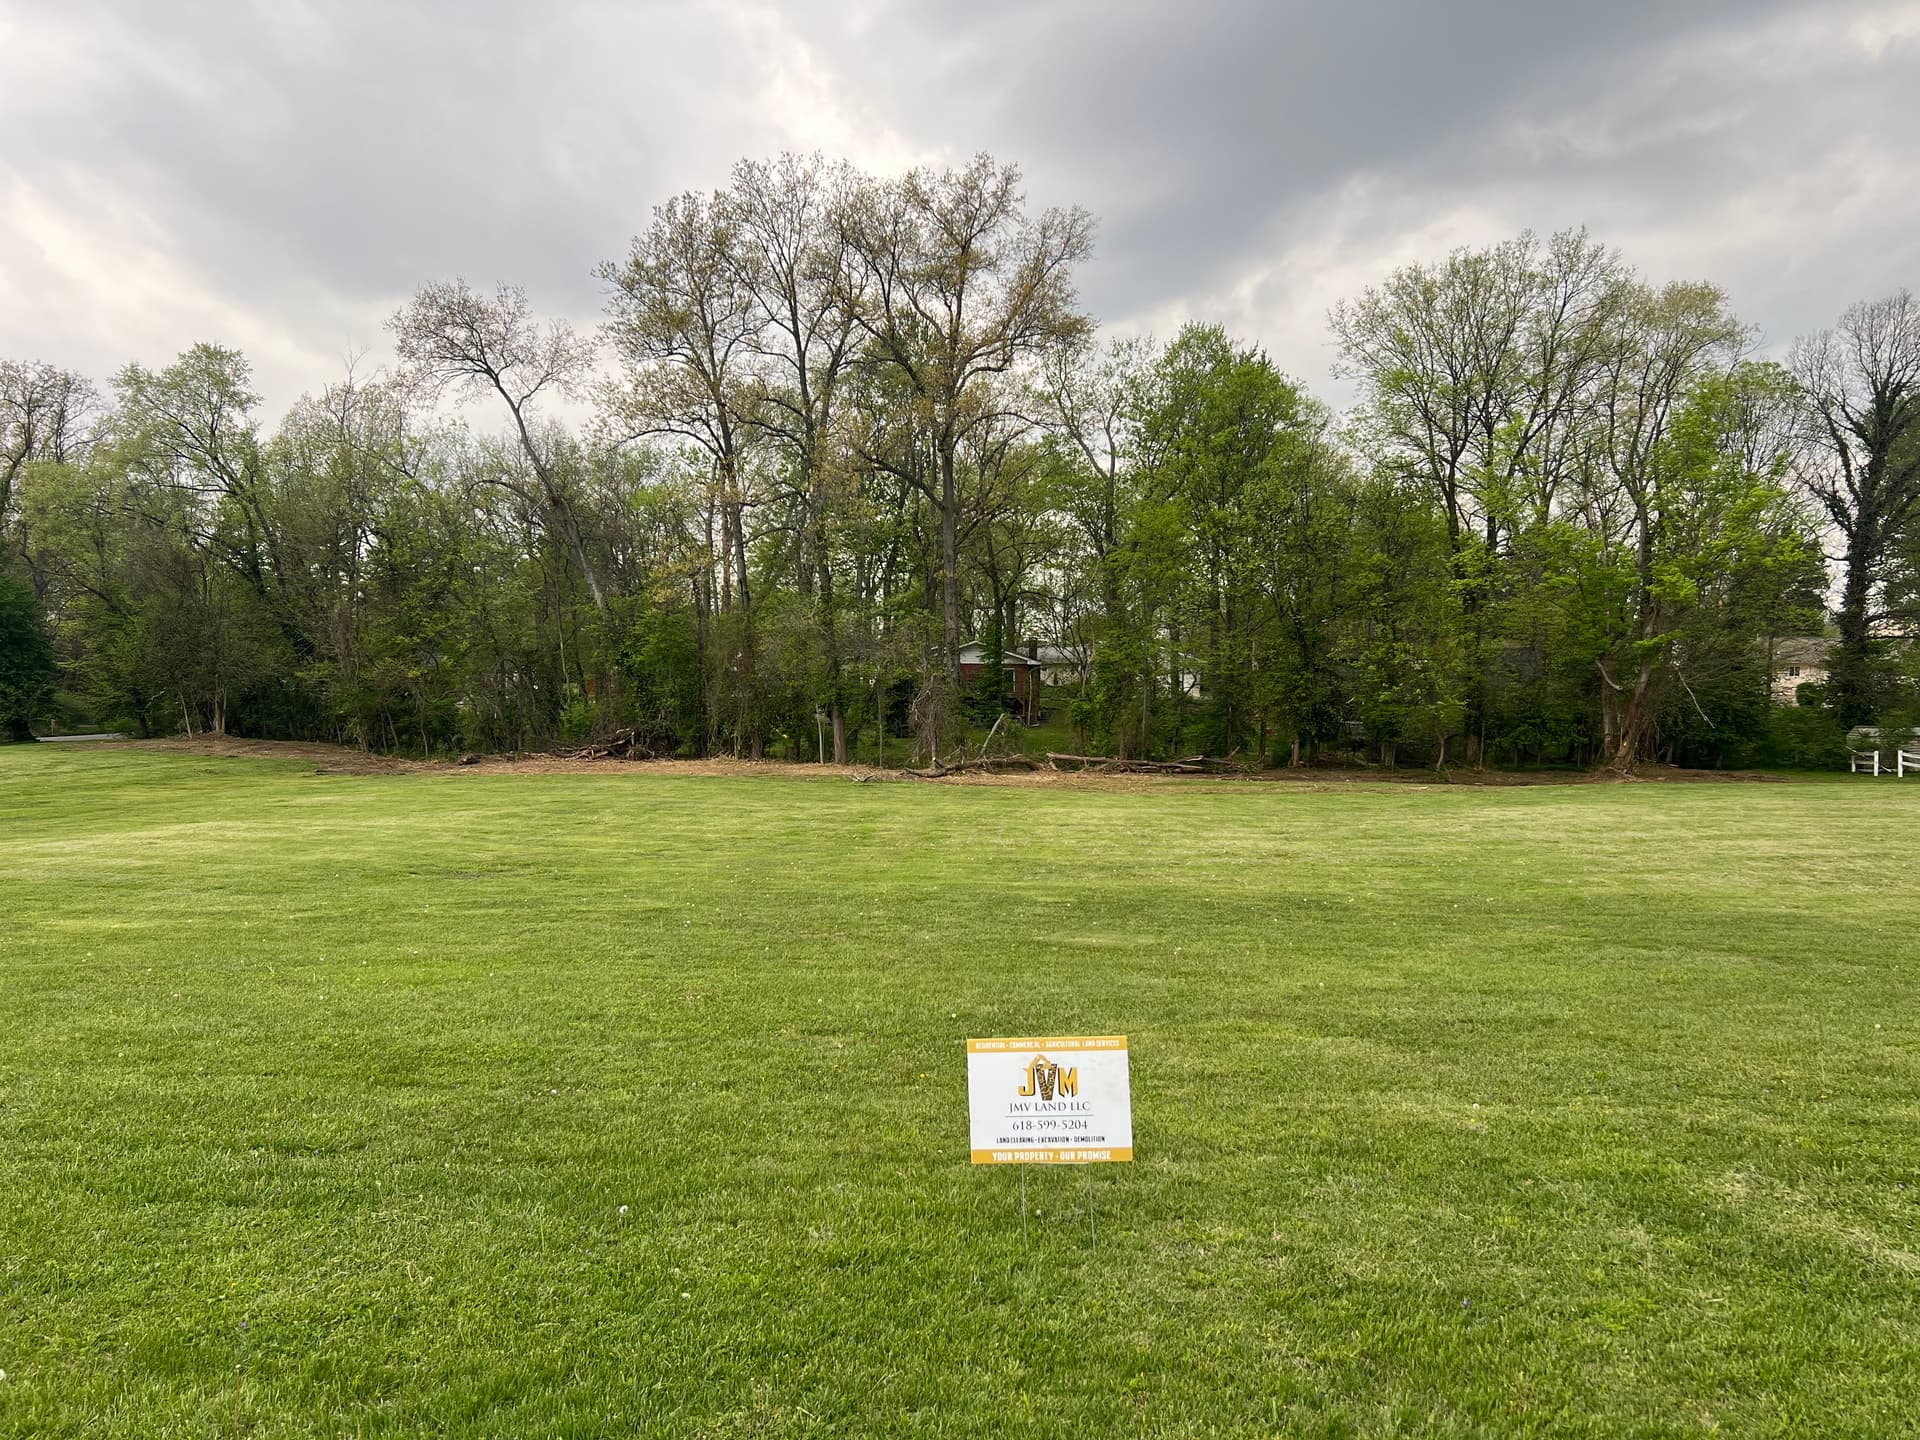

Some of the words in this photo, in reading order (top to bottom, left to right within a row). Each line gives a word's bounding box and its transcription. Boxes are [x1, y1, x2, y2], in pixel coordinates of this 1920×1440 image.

[1009, 1103, 1031, 1113] JMV
[1035, 1102, 1067, 1112] LAND
[1071, 1101, 1091, 1111] LLC
[1012, 1119, 1088, 1130] 618-599-5204
[992, 1151, 1012, 1161] YOUR
[1014, 1151, 1054, 1161] PROPERTY
[1060, 1151, 1074, 1160] OUR
[1077, 1150, 1111, 1160] PROMISE
